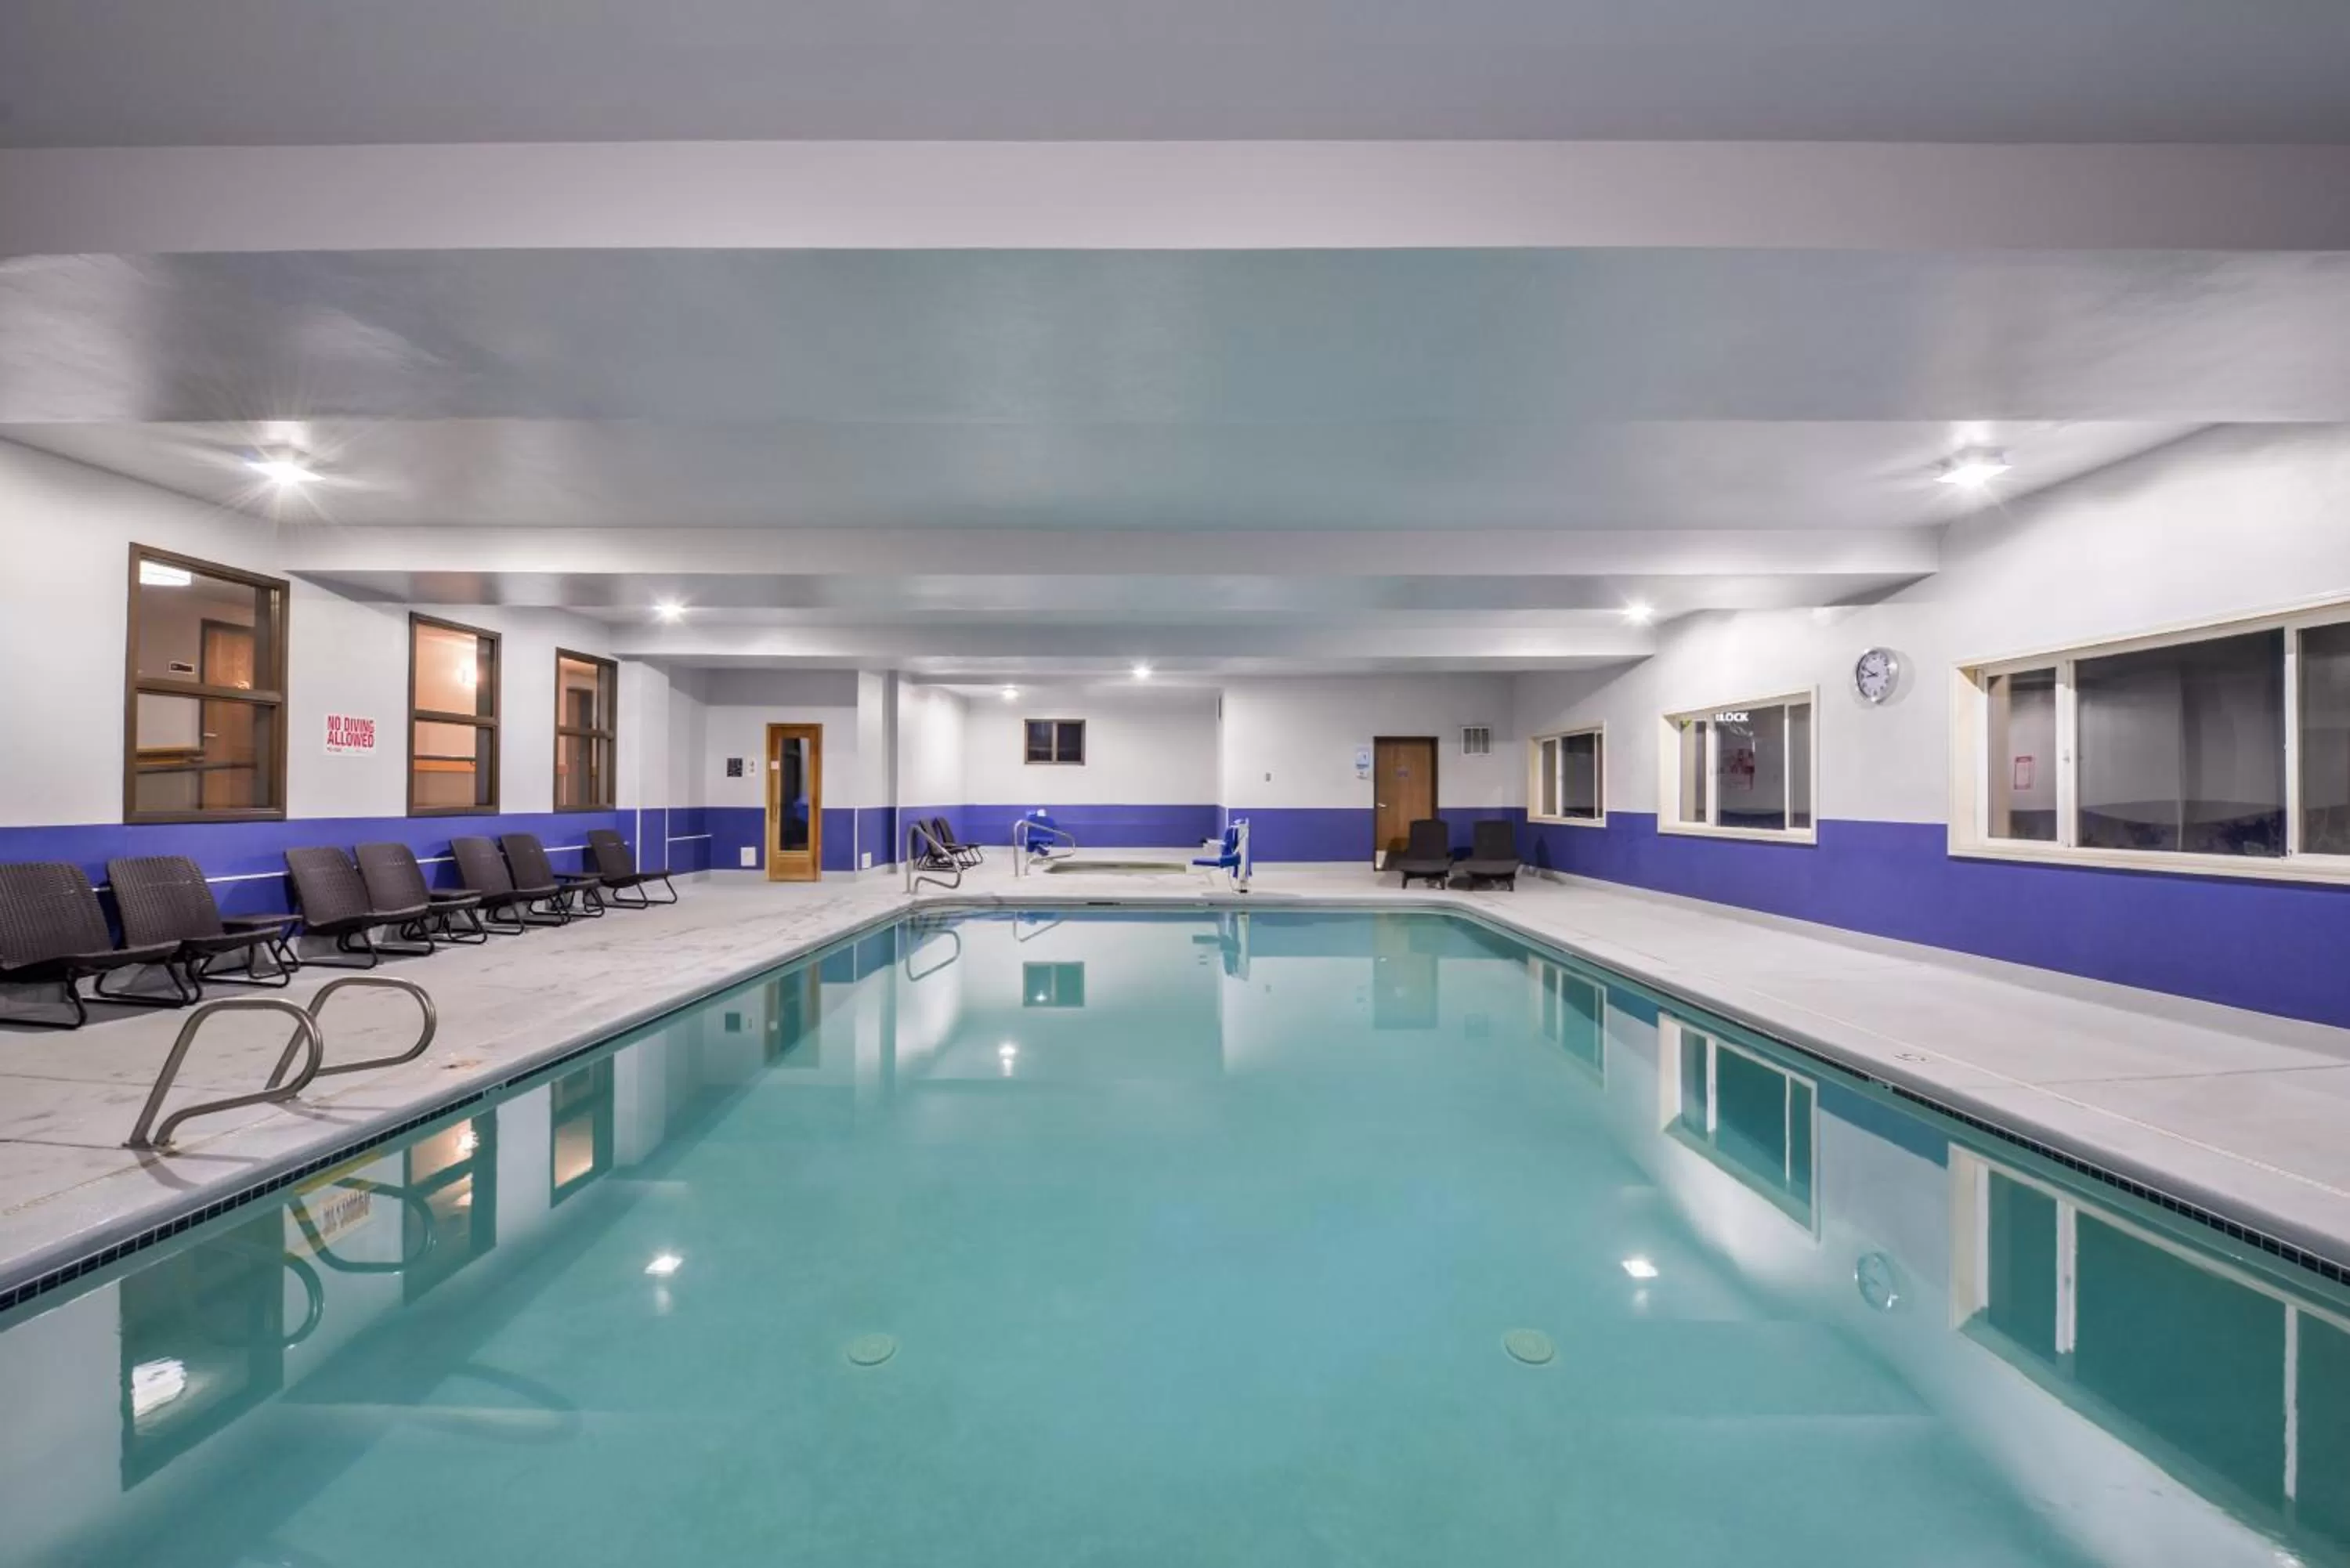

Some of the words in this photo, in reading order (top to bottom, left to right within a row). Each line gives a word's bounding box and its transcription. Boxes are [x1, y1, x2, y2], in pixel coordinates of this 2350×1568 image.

[327, 715, 341, 731] NO
[344, 717, 374, 734] DIVING
[327, 731, 374, 748] ALLOWED
